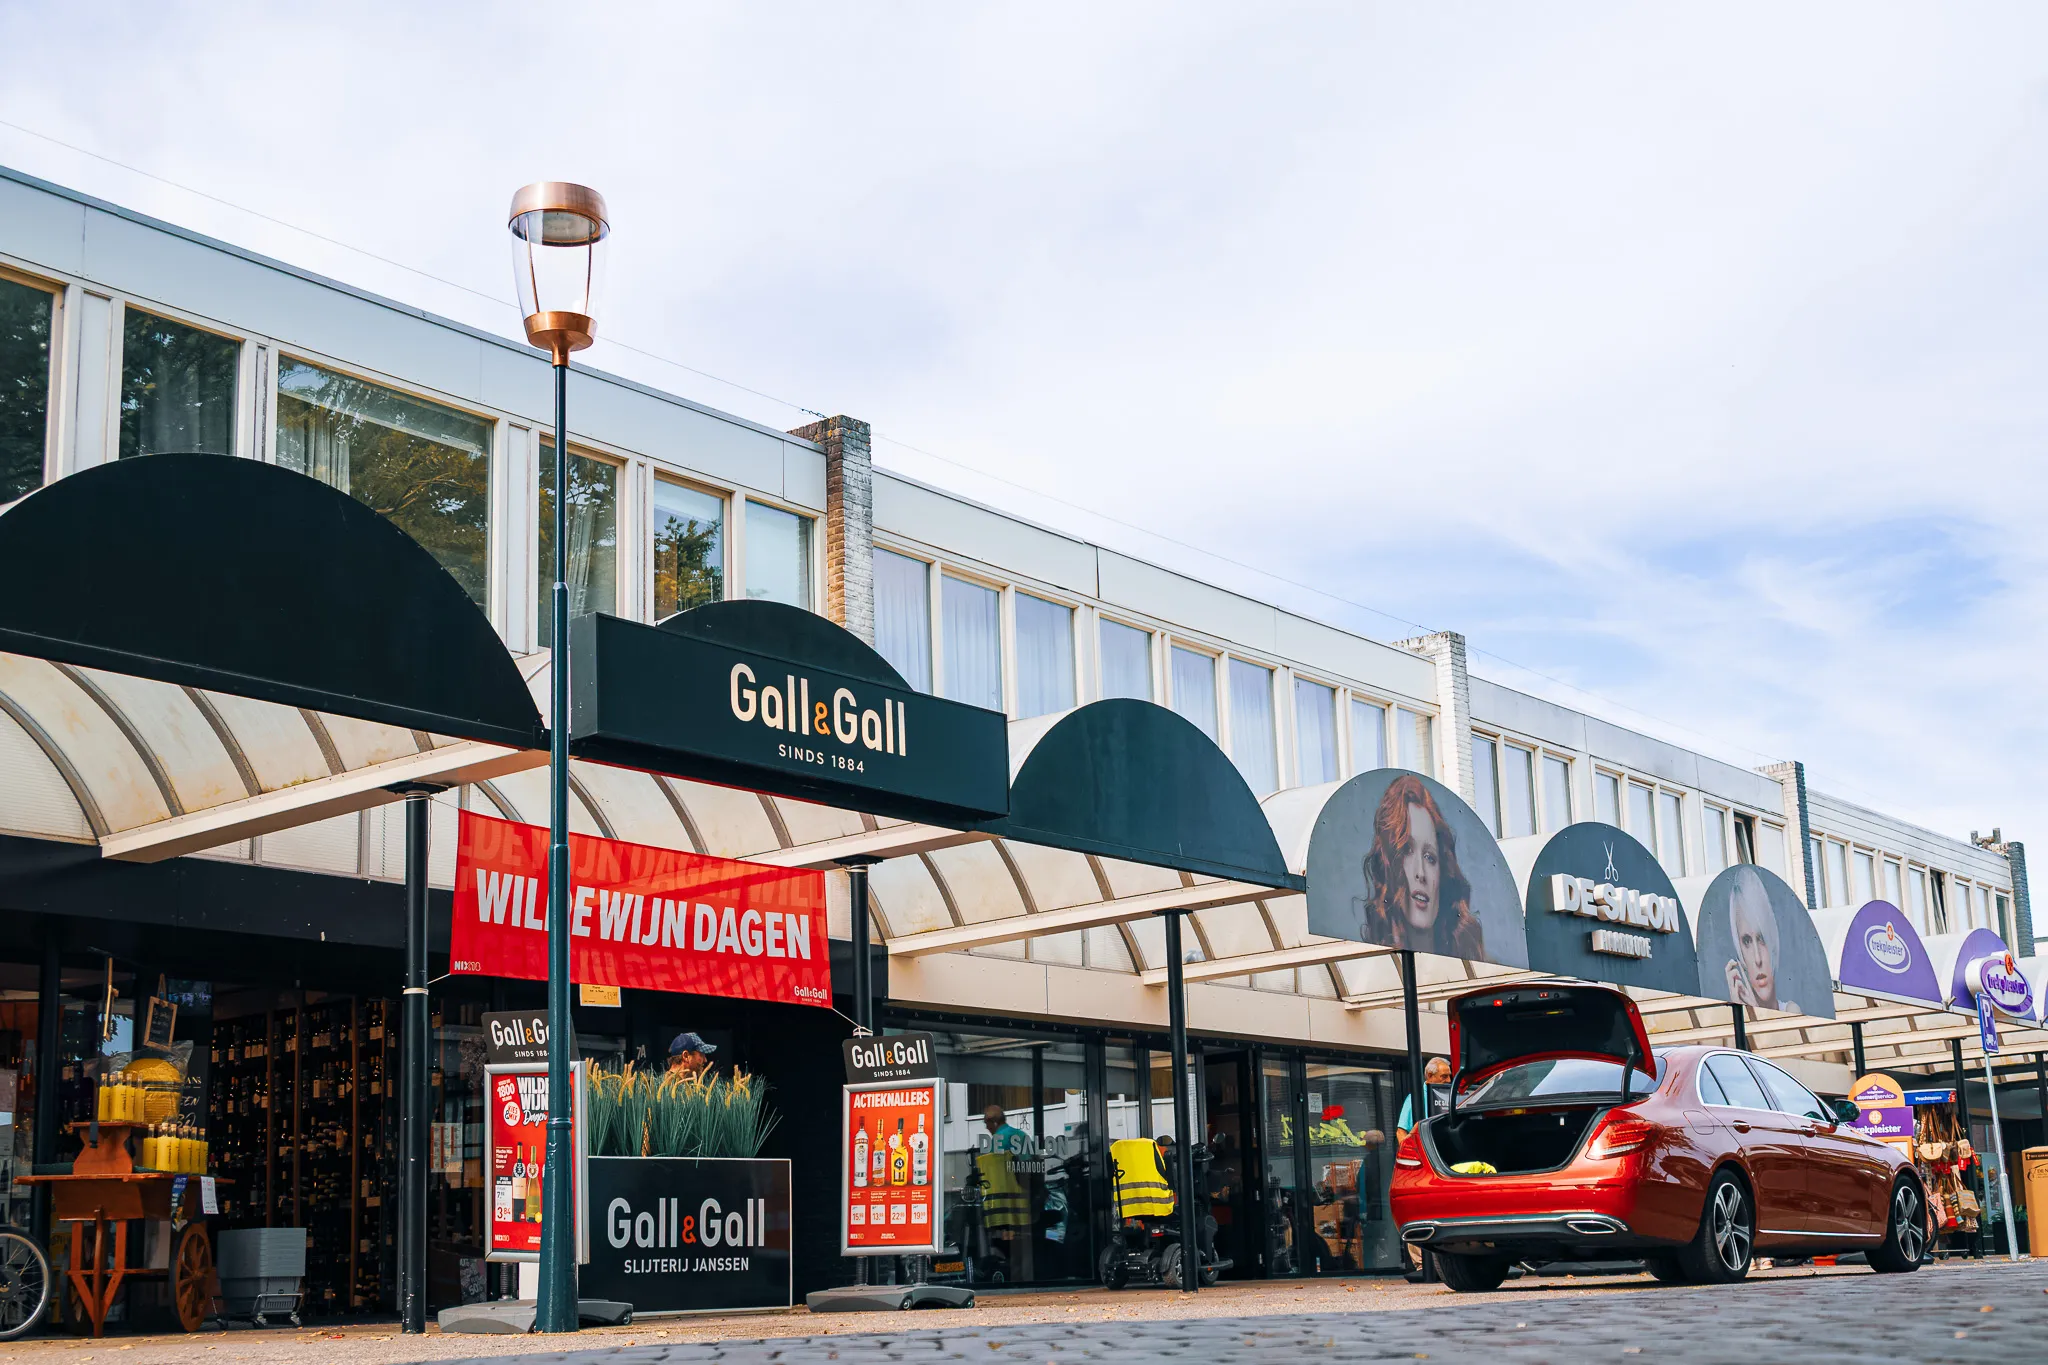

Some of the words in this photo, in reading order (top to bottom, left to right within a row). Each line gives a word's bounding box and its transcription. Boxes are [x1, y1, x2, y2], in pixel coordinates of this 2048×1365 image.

[730, 662, 907, 757] Gall&Gall
[778, 743, 825, 765] SINDS
[831, 755, 865, 773] 1884
[1552, 873, 1597, 917] DE
[1594, 883, 1680, 934] SALON
[599, 889, 688, 949] WIJN
[693, 903, 812, 960] DAGEN
[1871, 939, 1904, 957] trekpleister
[794, 985, 828, 1000] Gall&Gall
[1987, 973, 2026, 995] trekpleister
[1982, 999, 1991, 1028] P
[490, 1018, 550, 1047] Gall&G
[514, 1050, 535, 1058] SINDS
[536, 1049, 550, 1057] 188
[636, 1044, 647, 1060] 7A
[851, 1040, 929, 1068] Gall&Gall
[873, 1070, 894, 1078] SINDS
[497, 1082, 515, 1098] 1800
[520, 1093, 549, 1111] WIJN
[853, 1091, 930, 1109] ACTIEKNALLERS
[978, 1133, 1005, 1154] DE
[1010, 1134, 1068, 1156] SALON
[1006, 1160, 1046, 1173] HAARMODE
[496, 1206, 511, 1221] 3.84
[607, 1197, 765, 1249] Gall&Gall
[624, 1258, 689, 1274] SLIJTERIJ
[692, 1257, 749, 1273] JANSSEN
